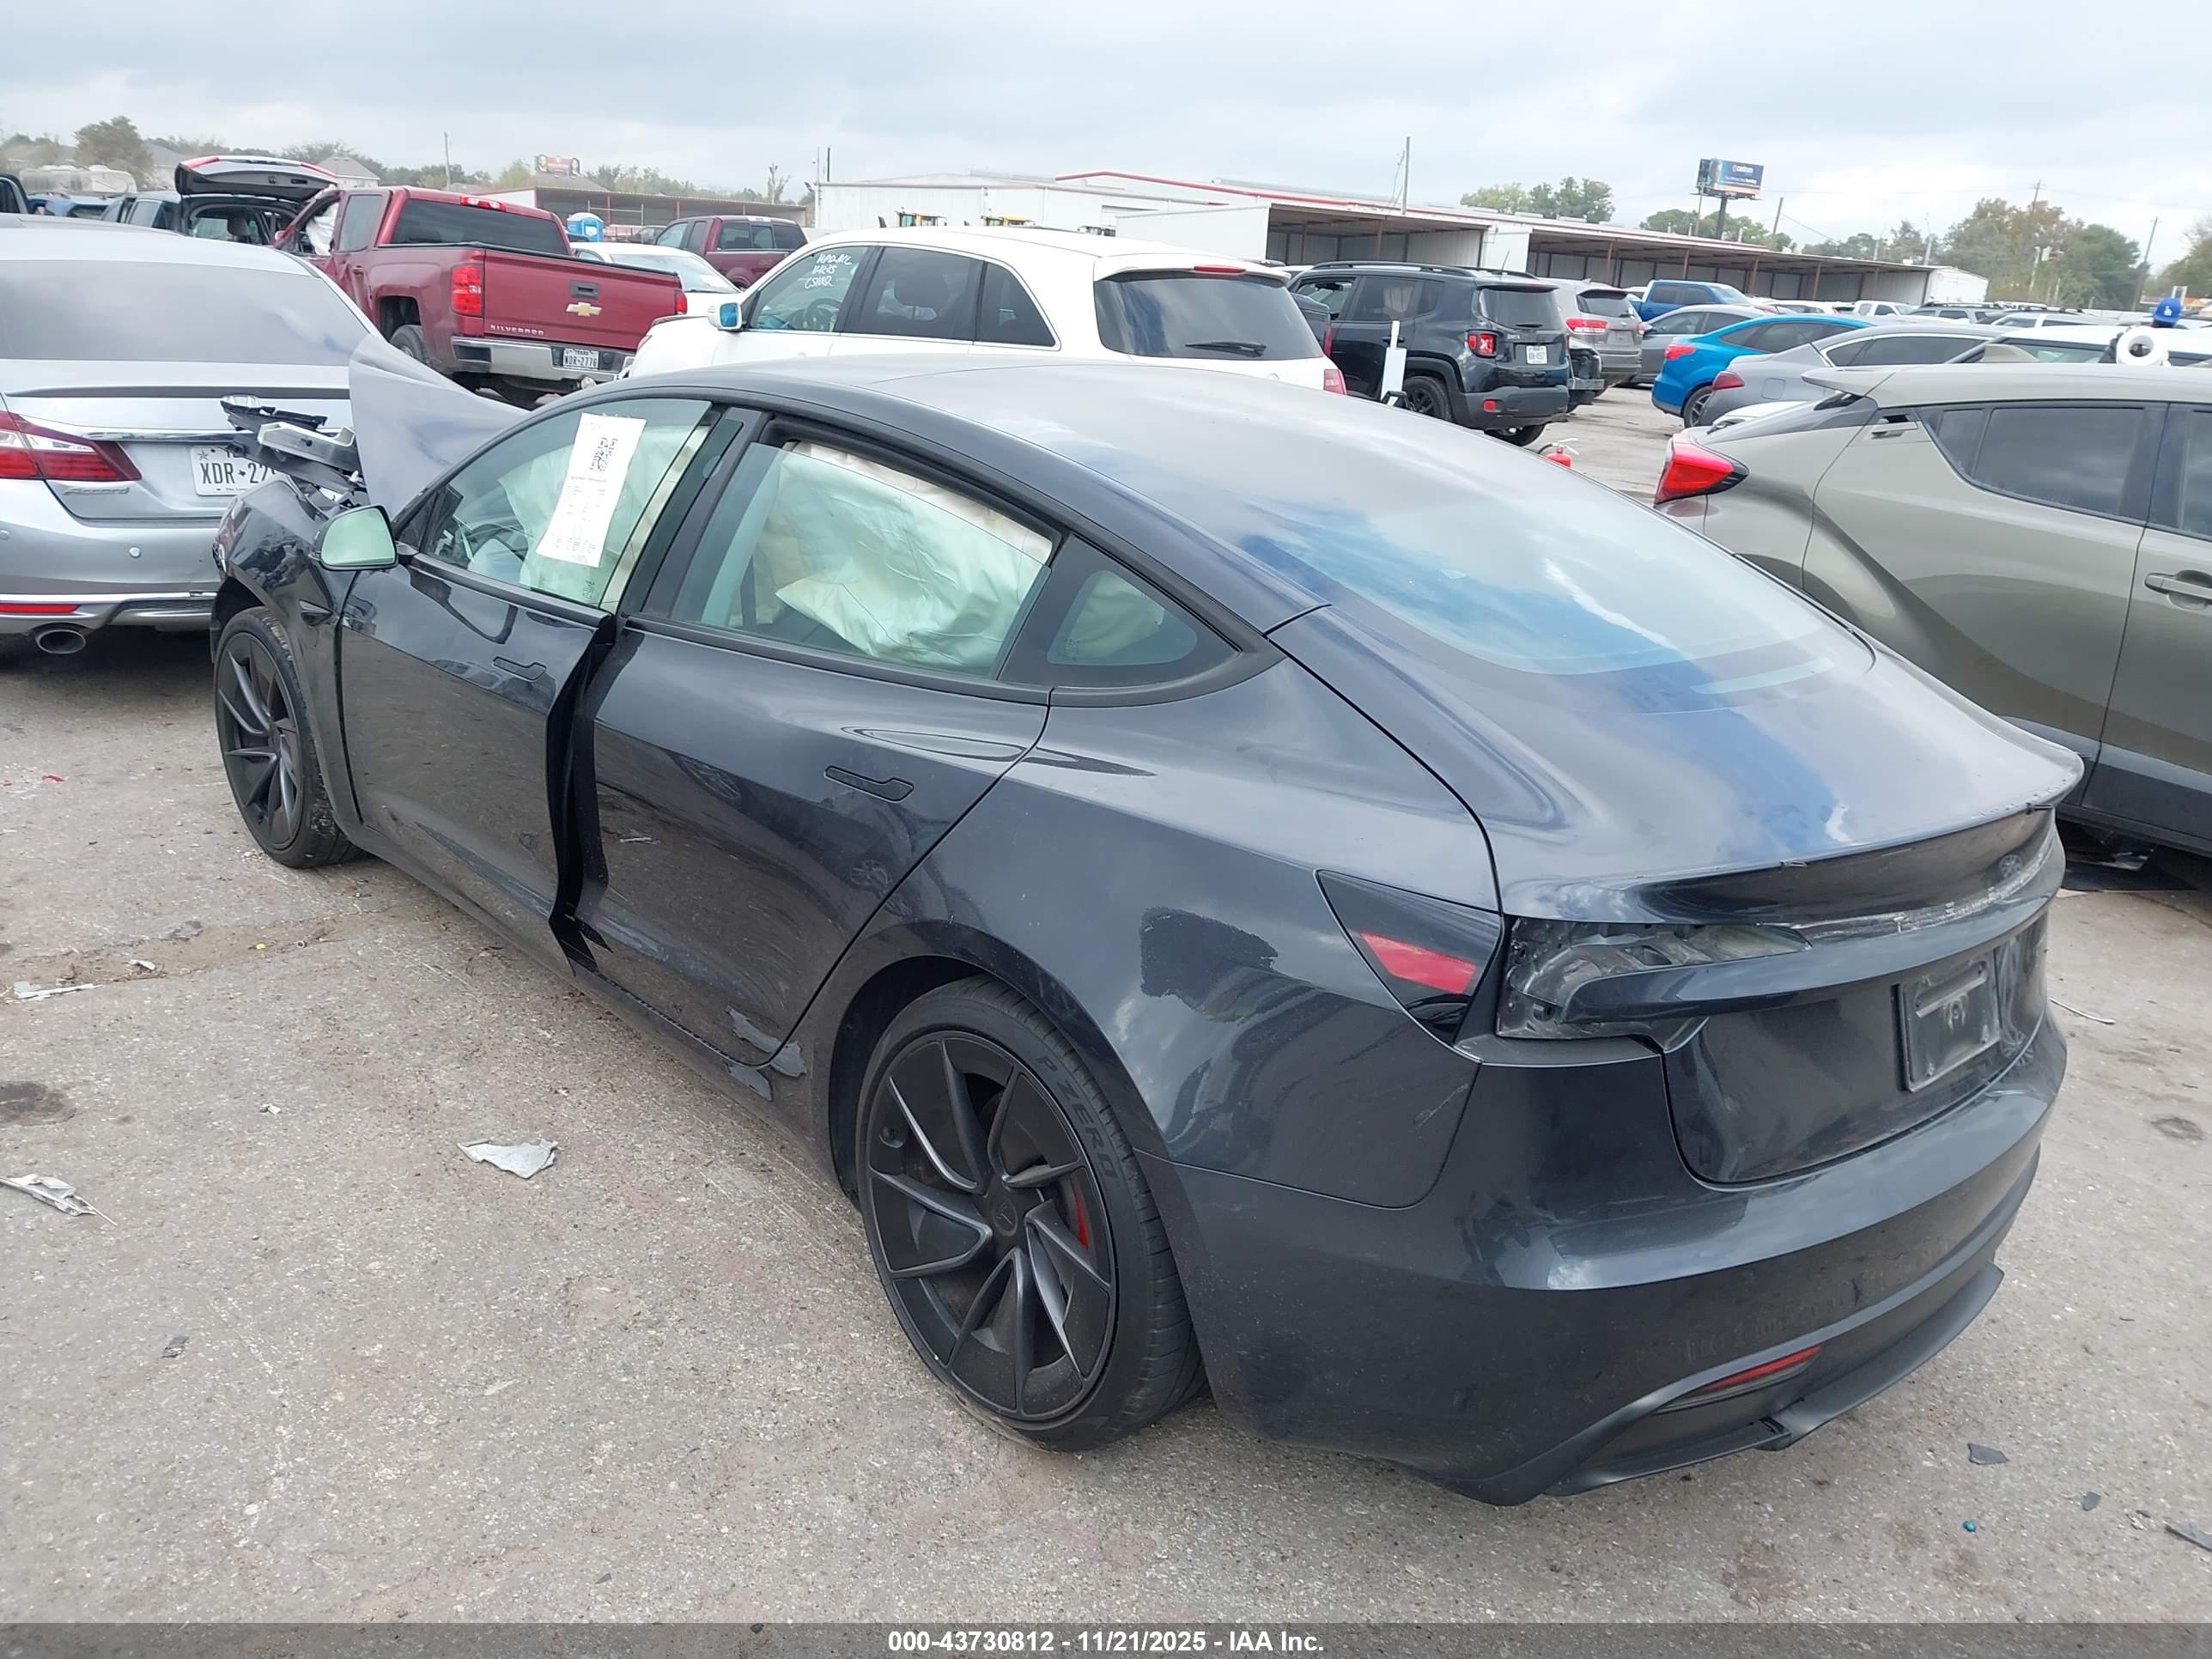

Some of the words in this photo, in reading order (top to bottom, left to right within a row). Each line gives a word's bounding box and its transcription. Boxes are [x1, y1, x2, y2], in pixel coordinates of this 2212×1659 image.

[490, 325, 544, 336] SILVERADO
[199, 462, 235, 484] XDR
[62, 486, 130, 495] Accord
[1056, 1079, 1118, 1178] ZERO
